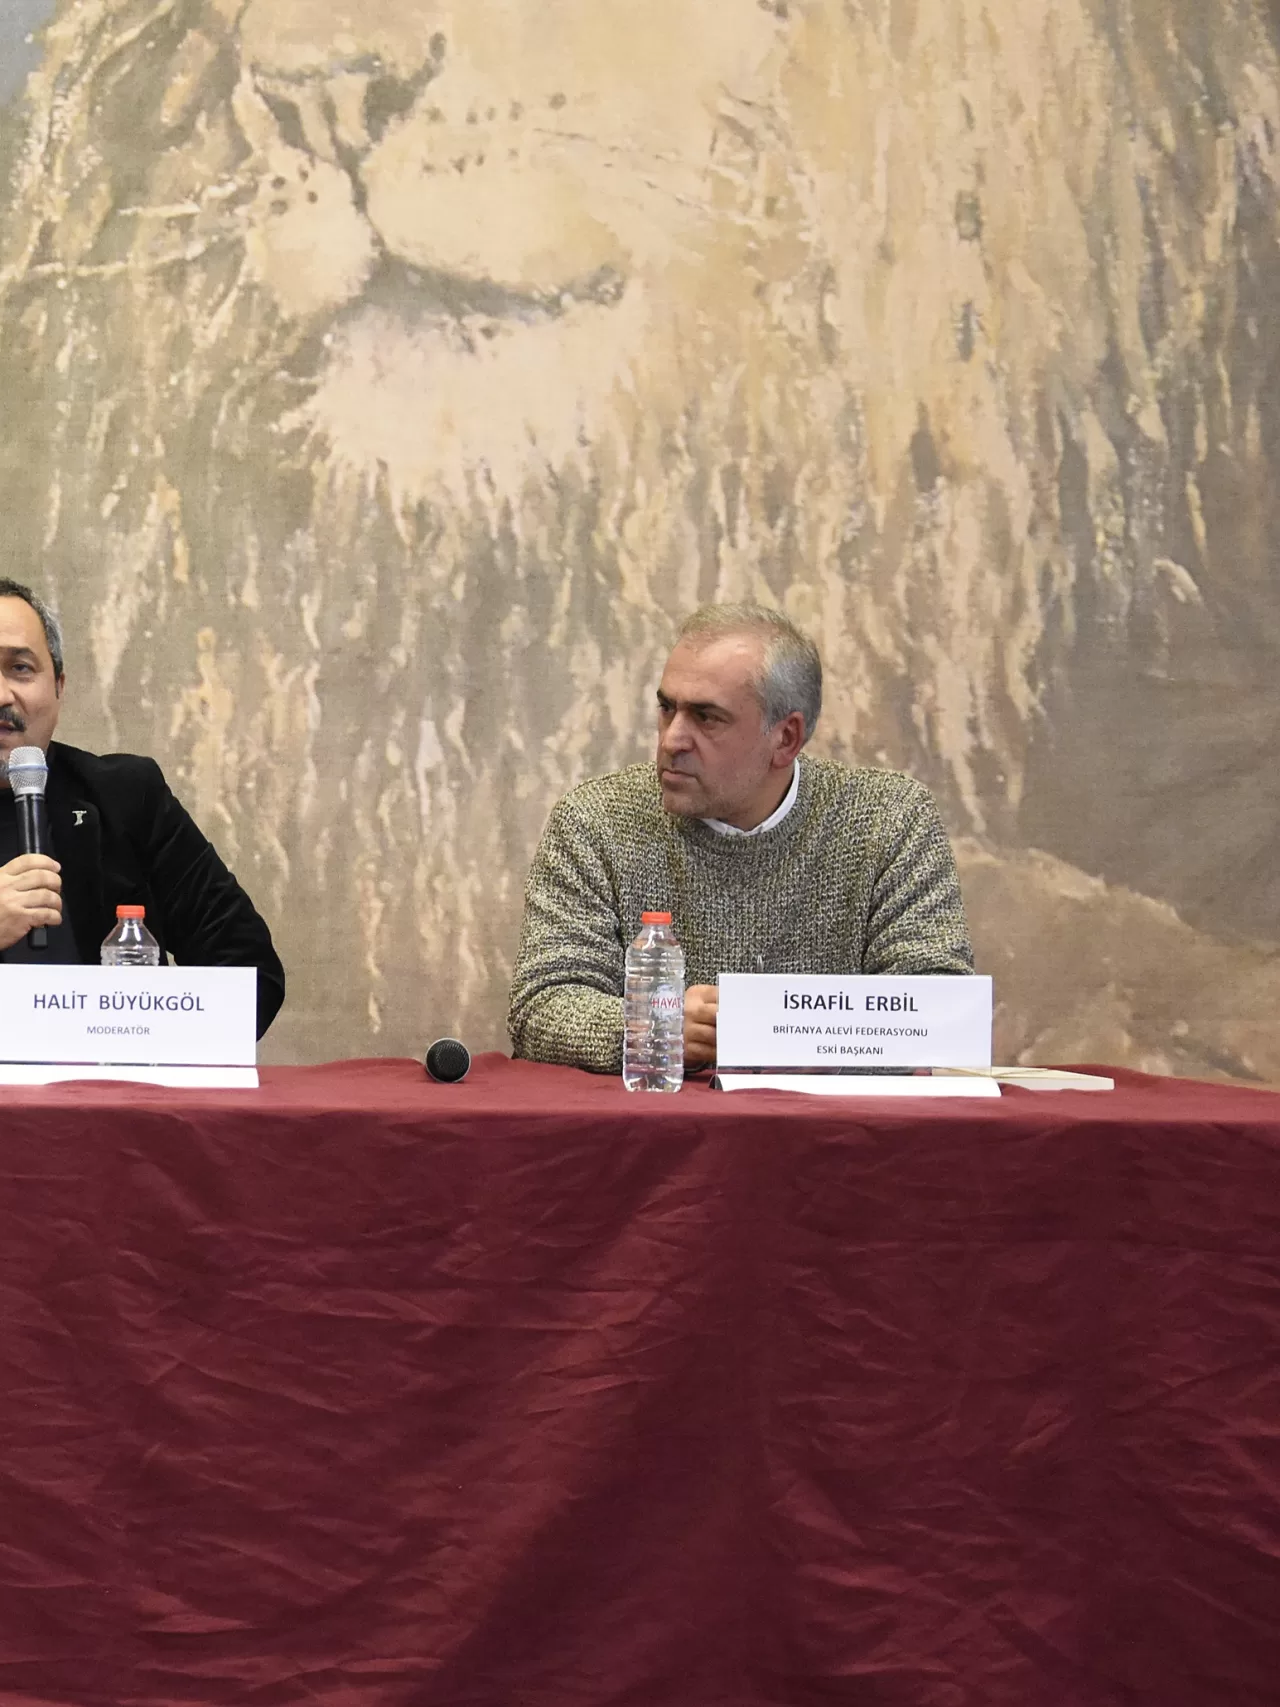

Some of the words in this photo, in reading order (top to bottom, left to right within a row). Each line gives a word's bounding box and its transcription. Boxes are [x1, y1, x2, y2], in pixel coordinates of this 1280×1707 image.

[33, 990, 88, 1010] HALİT
[99, 991, 205, 1012] BÜYÜKGÖL
[783, 989, 855, 1011] İSRAFİL
[865, 992, 919, 1012] ERBİL
[86, 1024, 150, 1035] MODERATÖR
[772, 1023, 823, 1035] BRİTANYA
[824, 1025, 853, 1036] ALEVİ
[855, 1026, 928, 1037] FEDERASYONU
[816, 1043, 838, 1055] ESKİ
[839, 1045, 884, 1057] BAŞKANI
